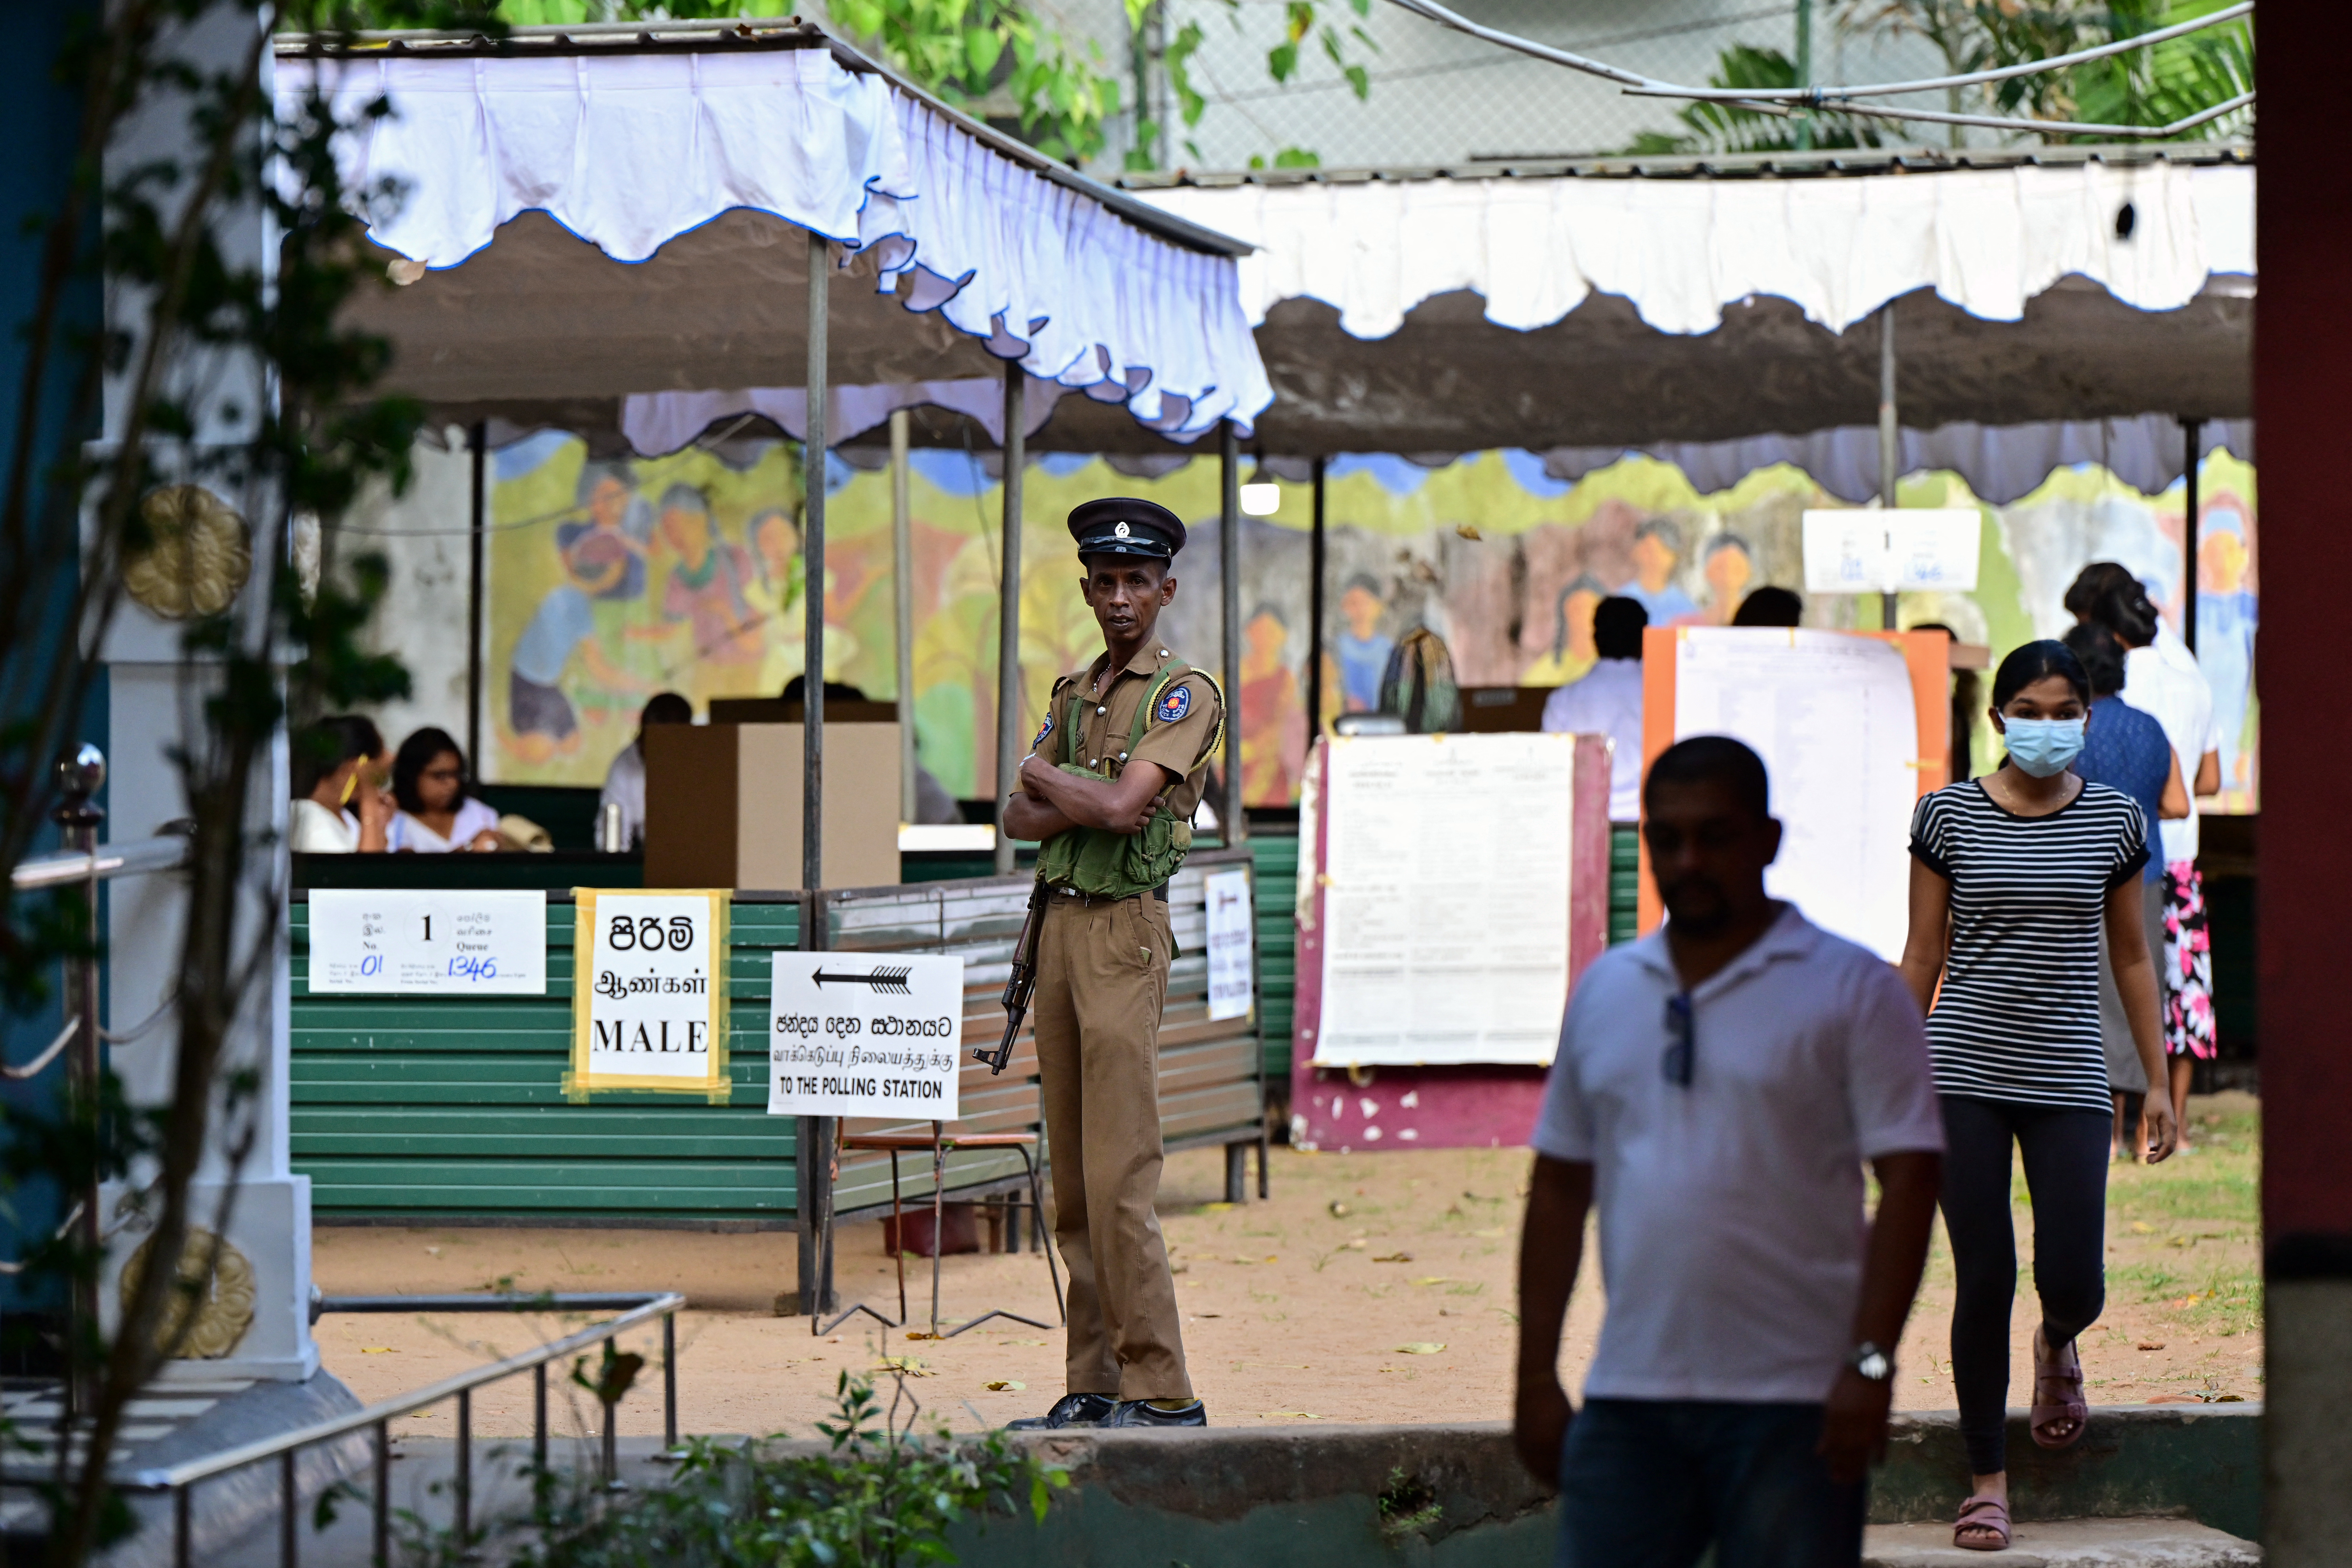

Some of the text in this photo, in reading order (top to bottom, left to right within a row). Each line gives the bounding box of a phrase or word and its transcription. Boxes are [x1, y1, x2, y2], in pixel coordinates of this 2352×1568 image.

[421, 914, 434, 942] 1
[609, 915, 694, 952] පිරිමි
[456, 941, 489, 953] Queue
[361, 954, 383, 976] 01
[448, 955, 498, 982] 1346
[594, 967, 708, 1000] ஆண்கள்
[592, 1018, 709, 1053] MALE
[776, 1012, 819, 1039] ඡන්දය
[825, 1016, 862, 1039] දෙන
[780, 1076, 943, 1099] TO THE POLLING STATION
